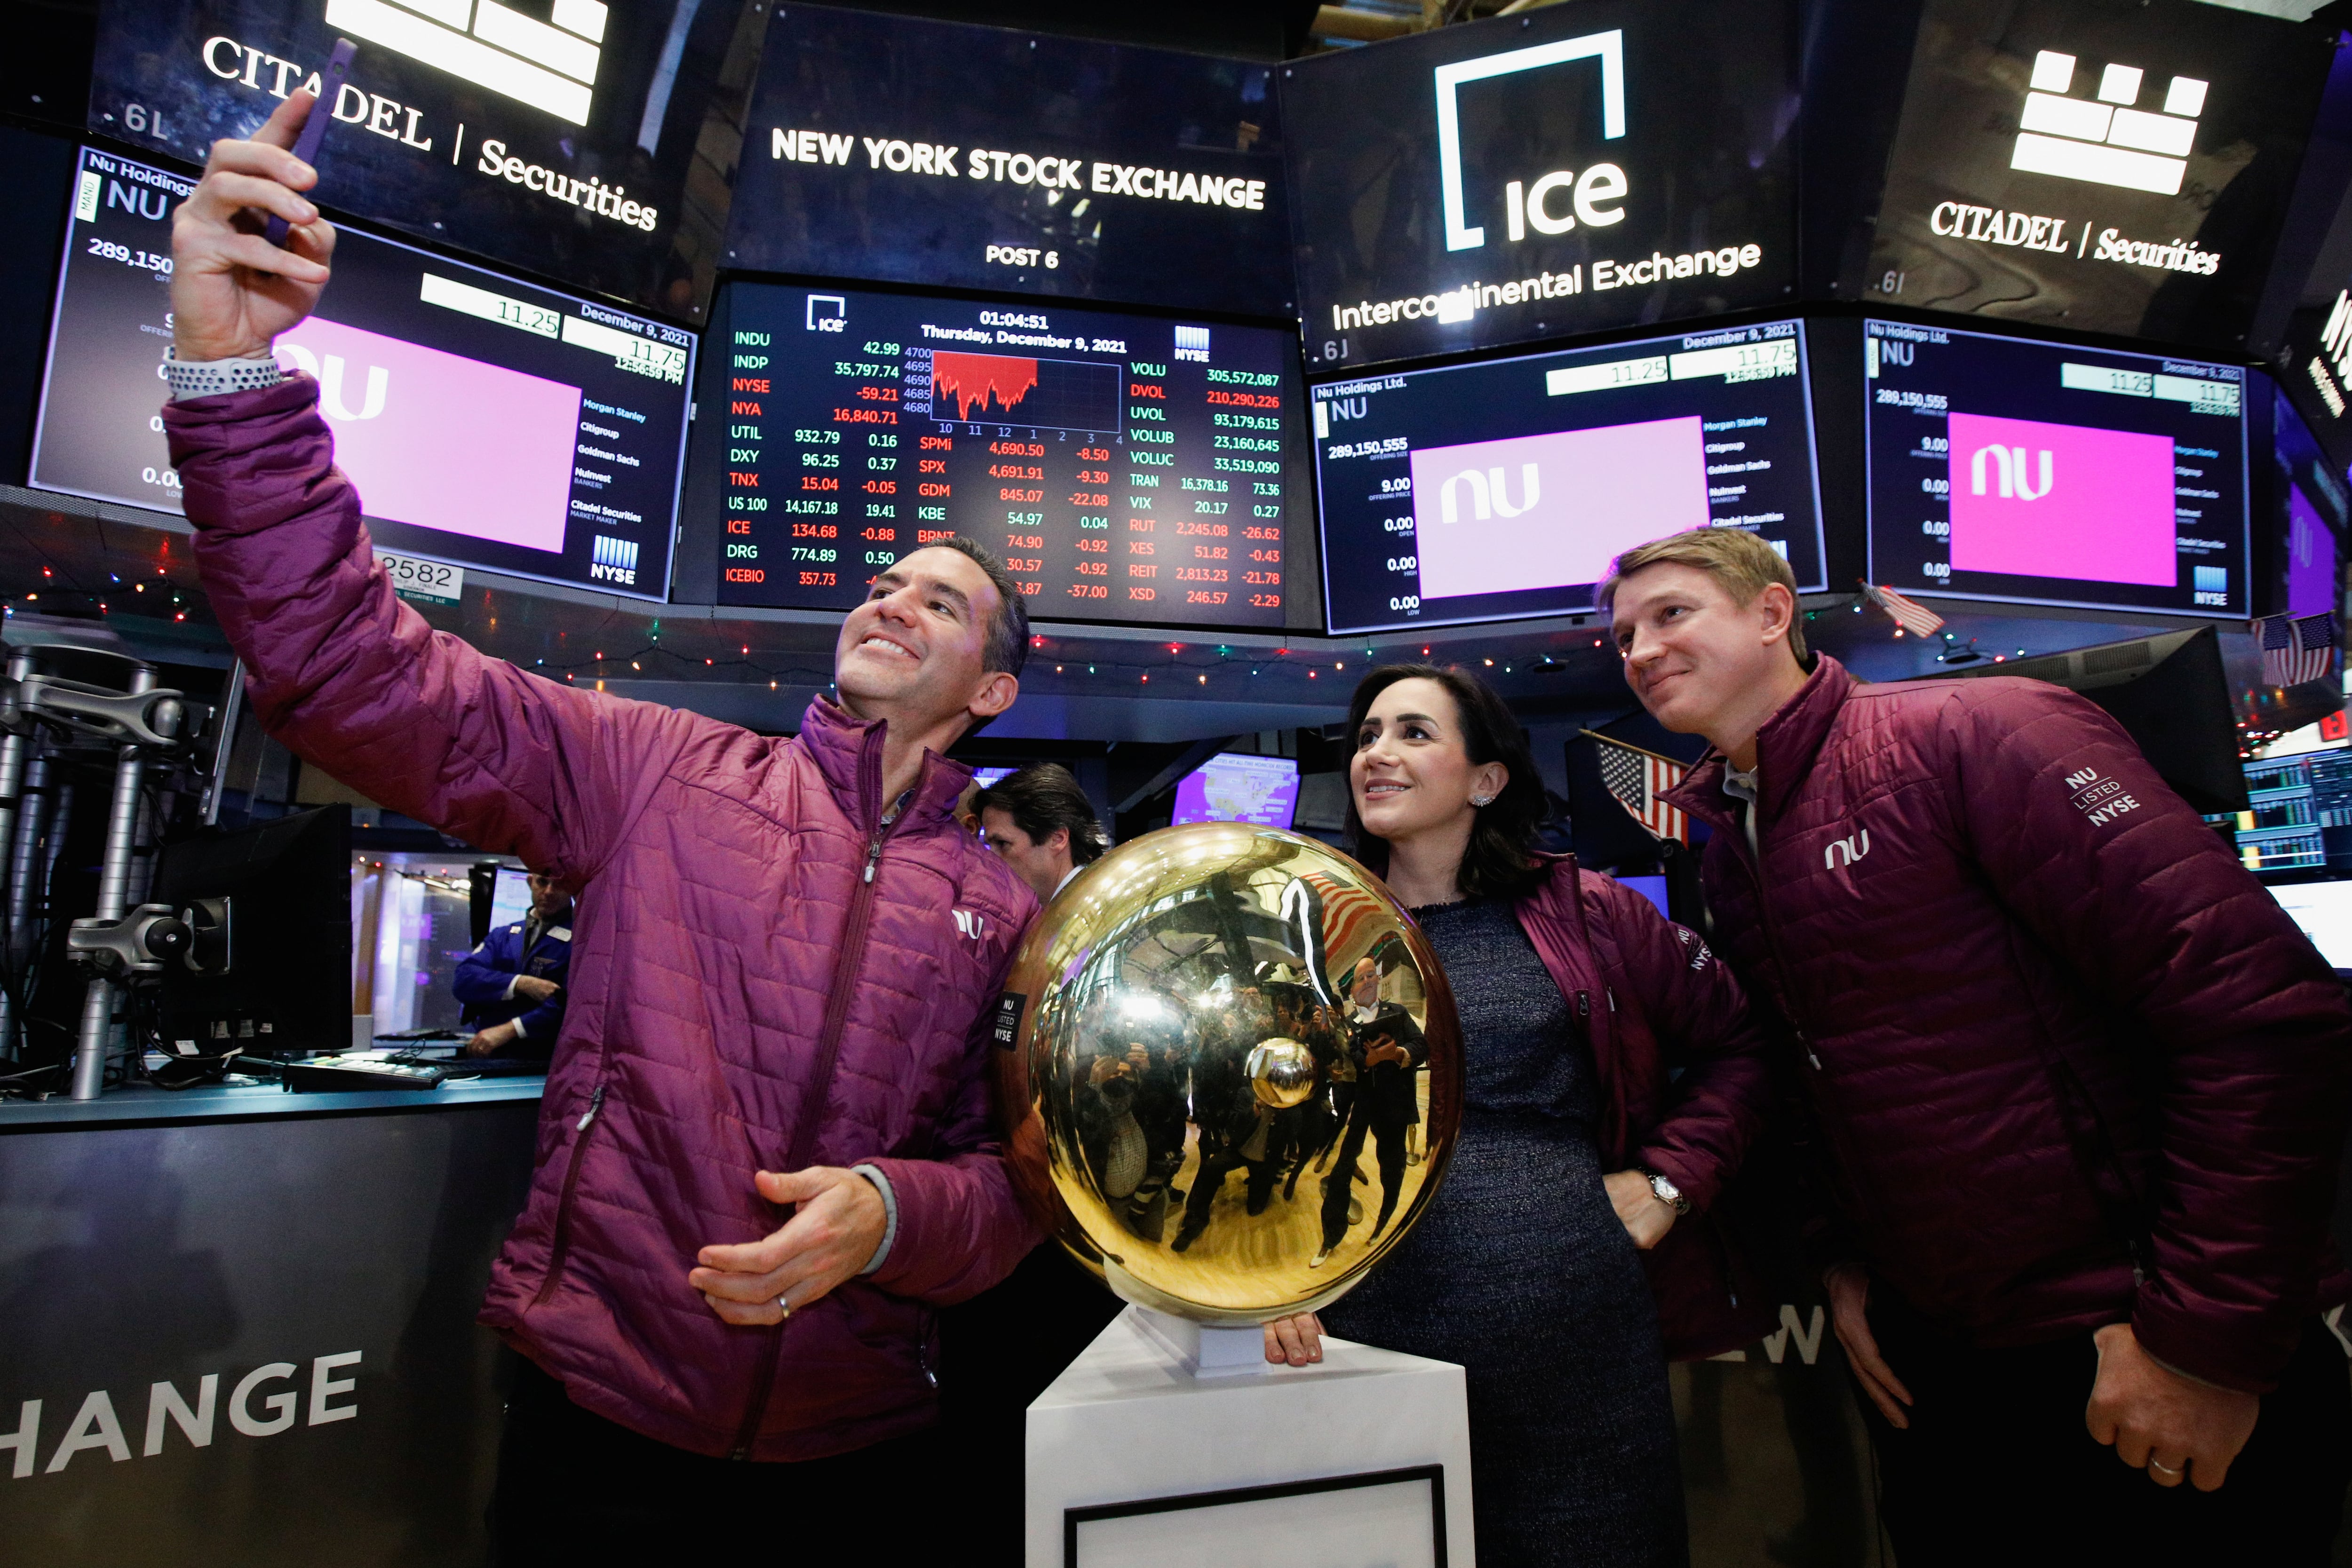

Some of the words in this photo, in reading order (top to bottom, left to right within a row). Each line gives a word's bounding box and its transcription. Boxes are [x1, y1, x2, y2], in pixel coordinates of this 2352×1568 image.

[125, 103, 171, 141] 6L
[203, 36, 432, 151] CITADEL
[478, 139, 657, 231] Securities
[89, 153, 116, 173] Nu
[120, 163, 196, 197] Holdings
[772, 128, 854, 166] NEW
[863, 137, 959, 177] YORK
[968, 149, 1082, 190] STOCK
[1091, 162, 1266, 210] EXCHANGE
[81, 182, 93, 210] MAND
[107, 180, 167, 220] NU
[1931, 201, 2069, 253] CITADEL
[2093, 228, 2221, 275] Securities
[986, 245, 1041, 267] POST
[1045, 251, 1058, 269] 6
[1333, 264, 1582, 333] Intercontinental
[1592, 244, 1761, 291] Exchange
[496, 301, 558, 334] 11.25
[580, 304, 645, 333] December
[645, 324, 658, 339] 9,
[660, 328, 690, 348] 2021
[978, 310, 1049, 329] 01:04:51
[735, 331, 770, 347] INDU
[863, 341, 900, 356] 42.99
[921, 324, 993, 344] Thursday,
[996, 330, 1073, 348] December
[1074, 337, 1089, 352] 9,
[1091, 339, 1128, 354] 2021
[1324, 339, 1348, 360] 6J
[628, 340, 685, 371] 11.75
[904, 346, 931, 359] 4700
[1174, 345, 1210, 363] NYSE
[1738, 343, 1796, 366] 11.75
[1882, 340, 1914, 366] NU
[614, 356, 662, 380] 12:56:59
[664, 372, 682, 385] PM
[734, 355, 769, 369] INDP
[834, 362, 899, 378] 35,797.74
[904, 360, 930, 372] 4695
[1131, 362, 1166, 377] VOLU
[1207, 369, 1279, 387] 305,572,087
[1612, 360, 1667, 383] 11.25
[733, 378, 770, 393] NYSE
[856, 387, 898, 402] -59.21
[903, 374, 930, 387] 4690
[1317, 387, 1334, 398] Nu
[1335, 380, 1383, 397] Holdings
[1384, 377, 1407, 389] Ltd.
[903, 388, 930, 400] 4685
[1130, 384, 1166, 399] DVOL
[1207, 391, 1280, 408] 210,290,226
[1876, 389, 1947, 409] 289,150,555
[583, 398, 615, 415] Morgan
[616, 407, 646, 424] Stanley
[732, 401, 762, 416] NYA
[834, 408, 898, 425] 16,840.71
[903, 402, 930, 414] 4680
[1130, 406, 1166, 421] UVOL
[1214, 413, 1279, 430] 93,179,615
[1331, 396, 1367, 421] NU
[580, 421, 620, 440] Citigroup
[731, 425, 763, 440] UTIL
[795, 429, 840, 444] 932.79
[868, 434, 898, 447] 0.16
[939, 423, 953, 434] 10
[969, 425, 982, 436] 11
[998, 427, 1011, 437] 12
[1130, 428, 1174, 443] VOLUB
[1214, 436, 1279, 452] 23,160,645
[577, 444, 616, 461] Goldman
[616, 453, 640, 467] Sachs
[731, 449, 760, 463] DXY
[802, 453, 839, 467] 96.25
[868, 457, 897, 470] 0.37
[920, 436, 952, 451] SPMi
[989, 442, 1045, 457] 4,690.50
[1076, 448, 1110, 461] -8.50
[1328, 437, 1408, 459] 289,150,555
[919, 459, 946, 474] SPX
[988, 464, 1044, 480] 4,691.91
[1076, 470, 1109, 484] -9.30
[1130, 451, 1174, 466] VOLUC
[1214, 458, 1279, 474] 33,519,090
[574, 467, 612, 483] NuInvest
[574, 478, 603, 490] BANKERS
[729, 472, 758, 487] TNX
[802, 476, 839, 491] 15.04
[862, 480, 897, 494] -0.05
[1130, 473, 1159, 487] TRAN
[1181, 477, 1229, 492] 16,378.16
[1253, 483, 1280, 496] 73.36
[1381, 477, 1411, 492] 9.00
[919, 483, 951, 497] GDM
[1000, 488, 1044, 502] 845.07
[1068, 492, 1109, 507] -22.08
[570, 499, 601, 514] Citadel
[602, 507, 642, 523] Securities
[570, 510, 595, 521] MARKET
[596, 516, 617, 525] MAKER
[729, 496, 744, 510] US
[747, 498, 767, 511] 100
[785, 499, 838, 515] 14,167.18
[866, 504, 896, 518] 19.41
[918, 507, 946, 521] KBE
[1008, 512, 1043, 525] 54.97
[1081, 516, 1108, 529] 0.04
[1129, 496, 1152, 509] VIX
[1194, 500, 1228, 514] 20.17
[1253, 505, 1279, 518] 0.27
[728, 520, 751, 534] ICE
[792, 523, 837, 539] 134.68
[860, 527, 895, 541] -0.88
[1384, 516, 1414, 531] 0.00
[727, 544, 758, 559] DRG
[791, 547, 836, 562] 774.89
[865, 551, 894, 565] 0.50
[383, 557, 451, 586] 2582
[590, 563, 636, 585] NYSE
[726, 568, 765, 583] ICEBIO
[799, 571, 836, 586] 357.73
[2194, 591, 2227, 606] NYSE
[2065, 767, 2098, 789] NU
[2074, 781, 2120, 809] LISTED
[2088, 795, 2140, 827] NYSE
[1678, 928, 1690, 944] NU
[1003, 999, 1014, 1011] NU
[997, 1014, 1014, 1025] LISTED
[995, 1027, 1012, 1042] NYSE
